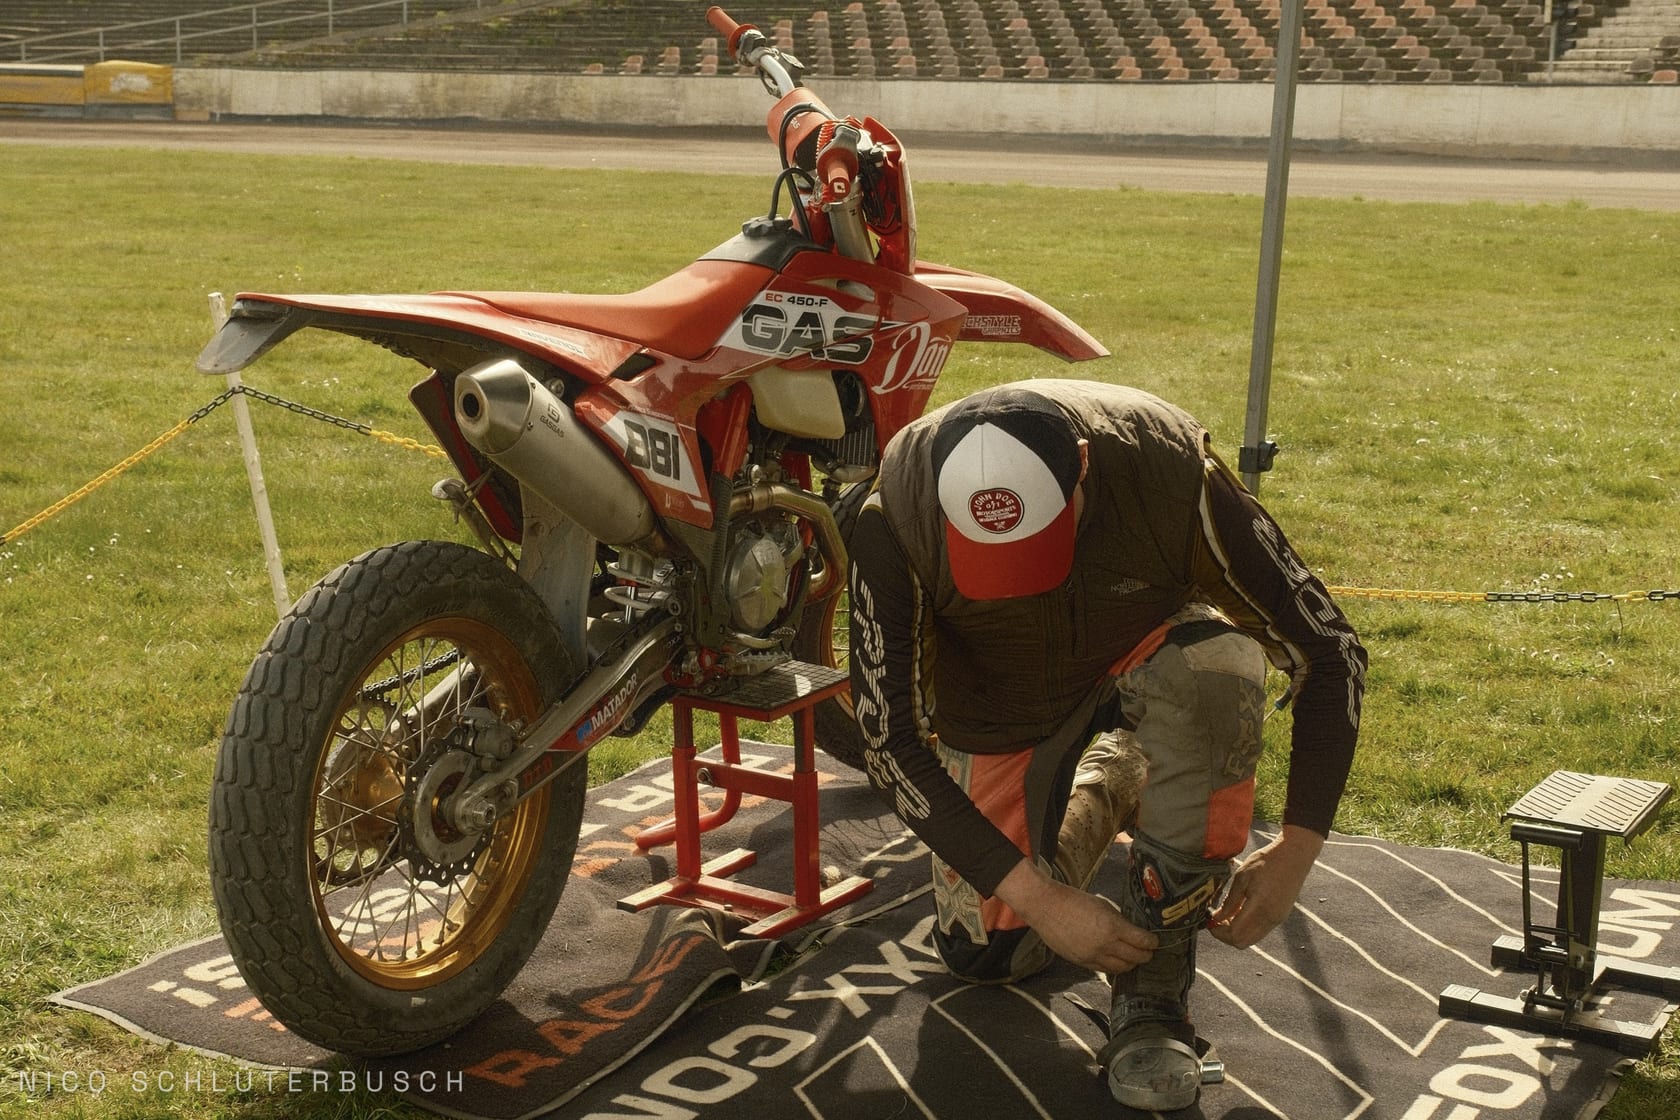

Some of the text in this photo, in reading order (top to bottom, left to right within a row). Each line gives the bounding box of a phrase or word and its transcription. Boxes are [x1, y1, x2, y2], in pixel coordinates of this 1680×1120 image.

[765, 293, 828, 307] EC 450-F
[741, 303, 874, 365] GAS
[974, 493, 992, 510] JOHN
[996, 492, 1014, 506] DOE
[591, 672, 638, 732] MATADOR
